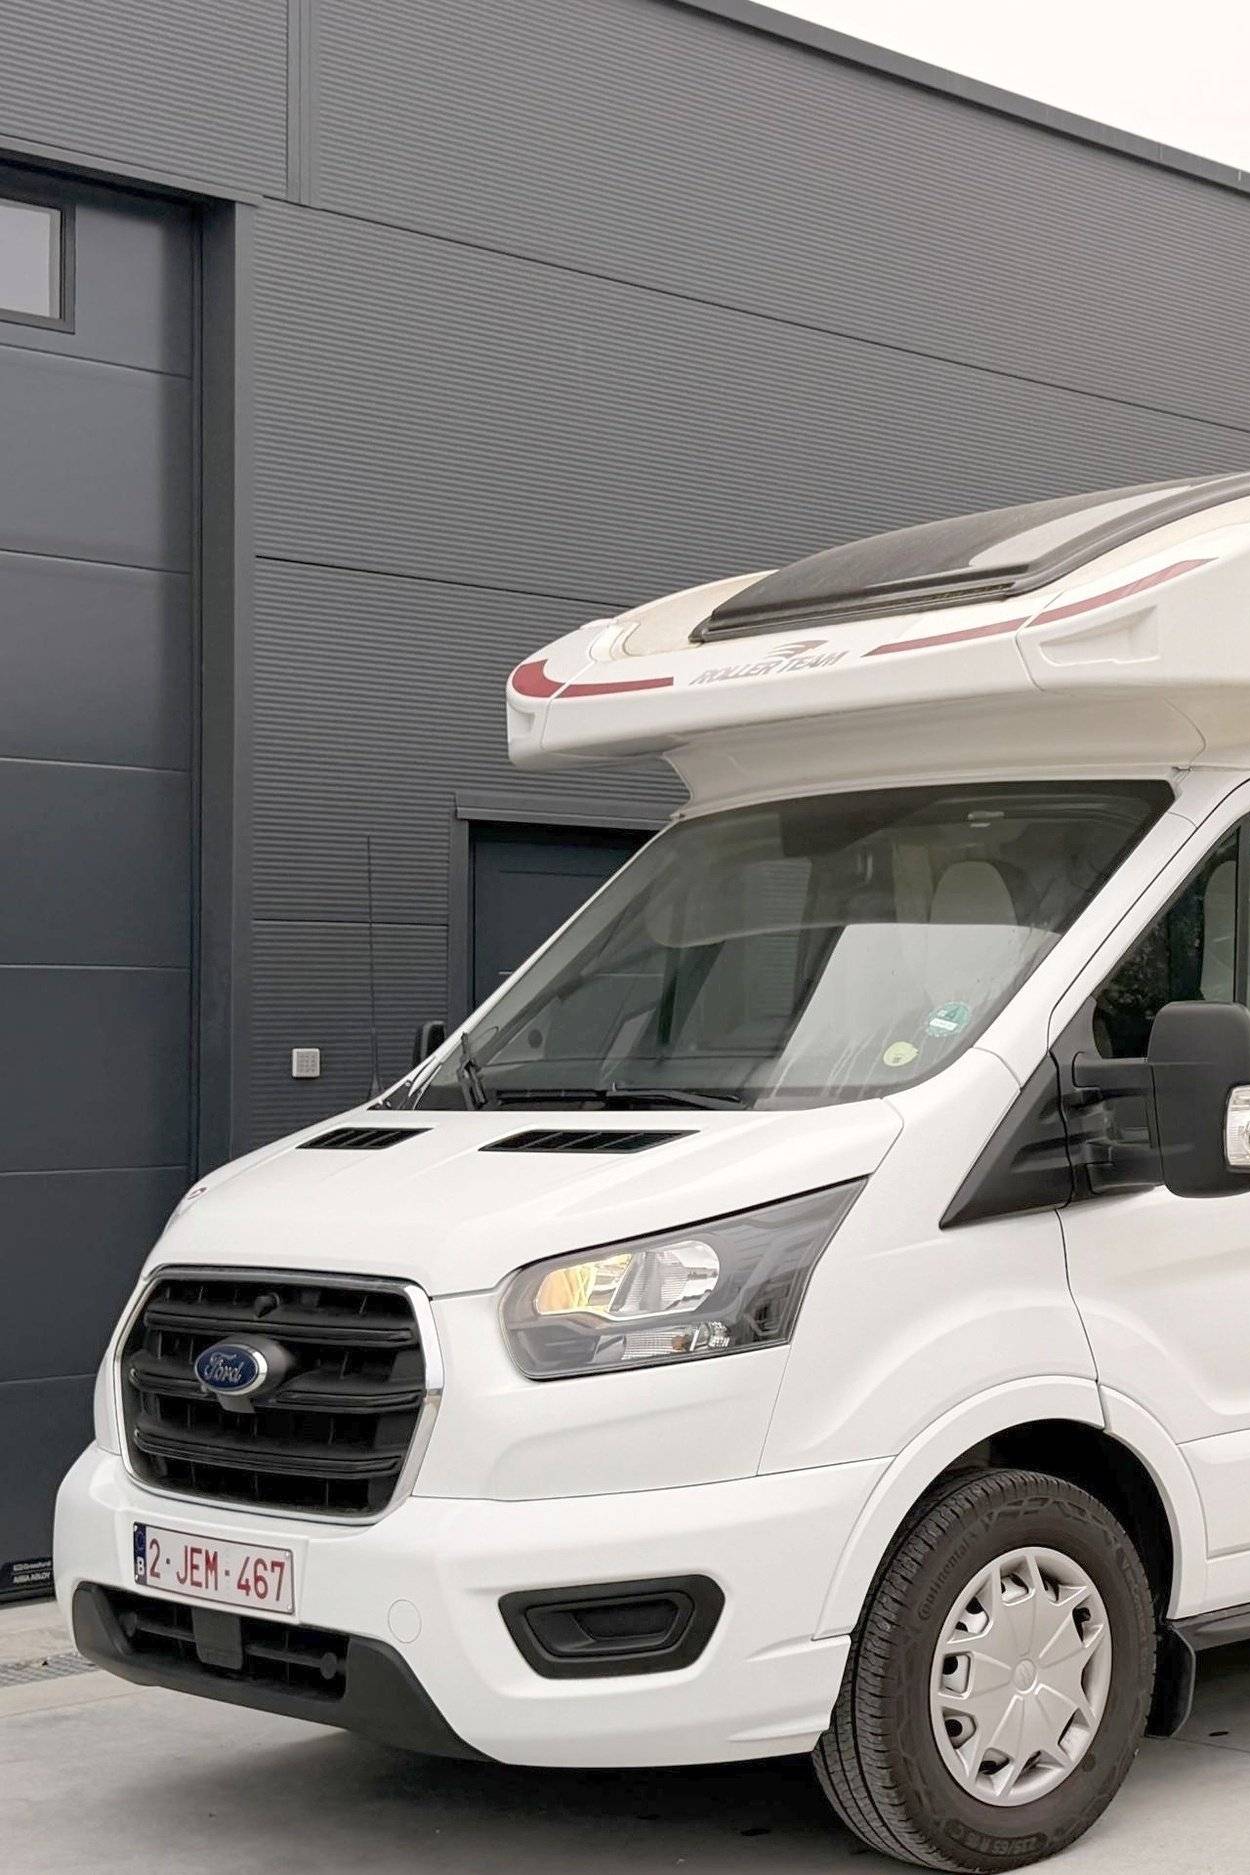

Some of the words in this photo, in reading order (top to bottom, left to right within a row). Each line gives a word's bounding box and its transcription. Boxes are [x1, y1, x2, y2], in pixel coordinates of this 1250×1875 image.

[777, 651, 849, 673] TEAM
[204, 1351, 245, 1383] Ford
[135, 1555, 145, 1576] B
